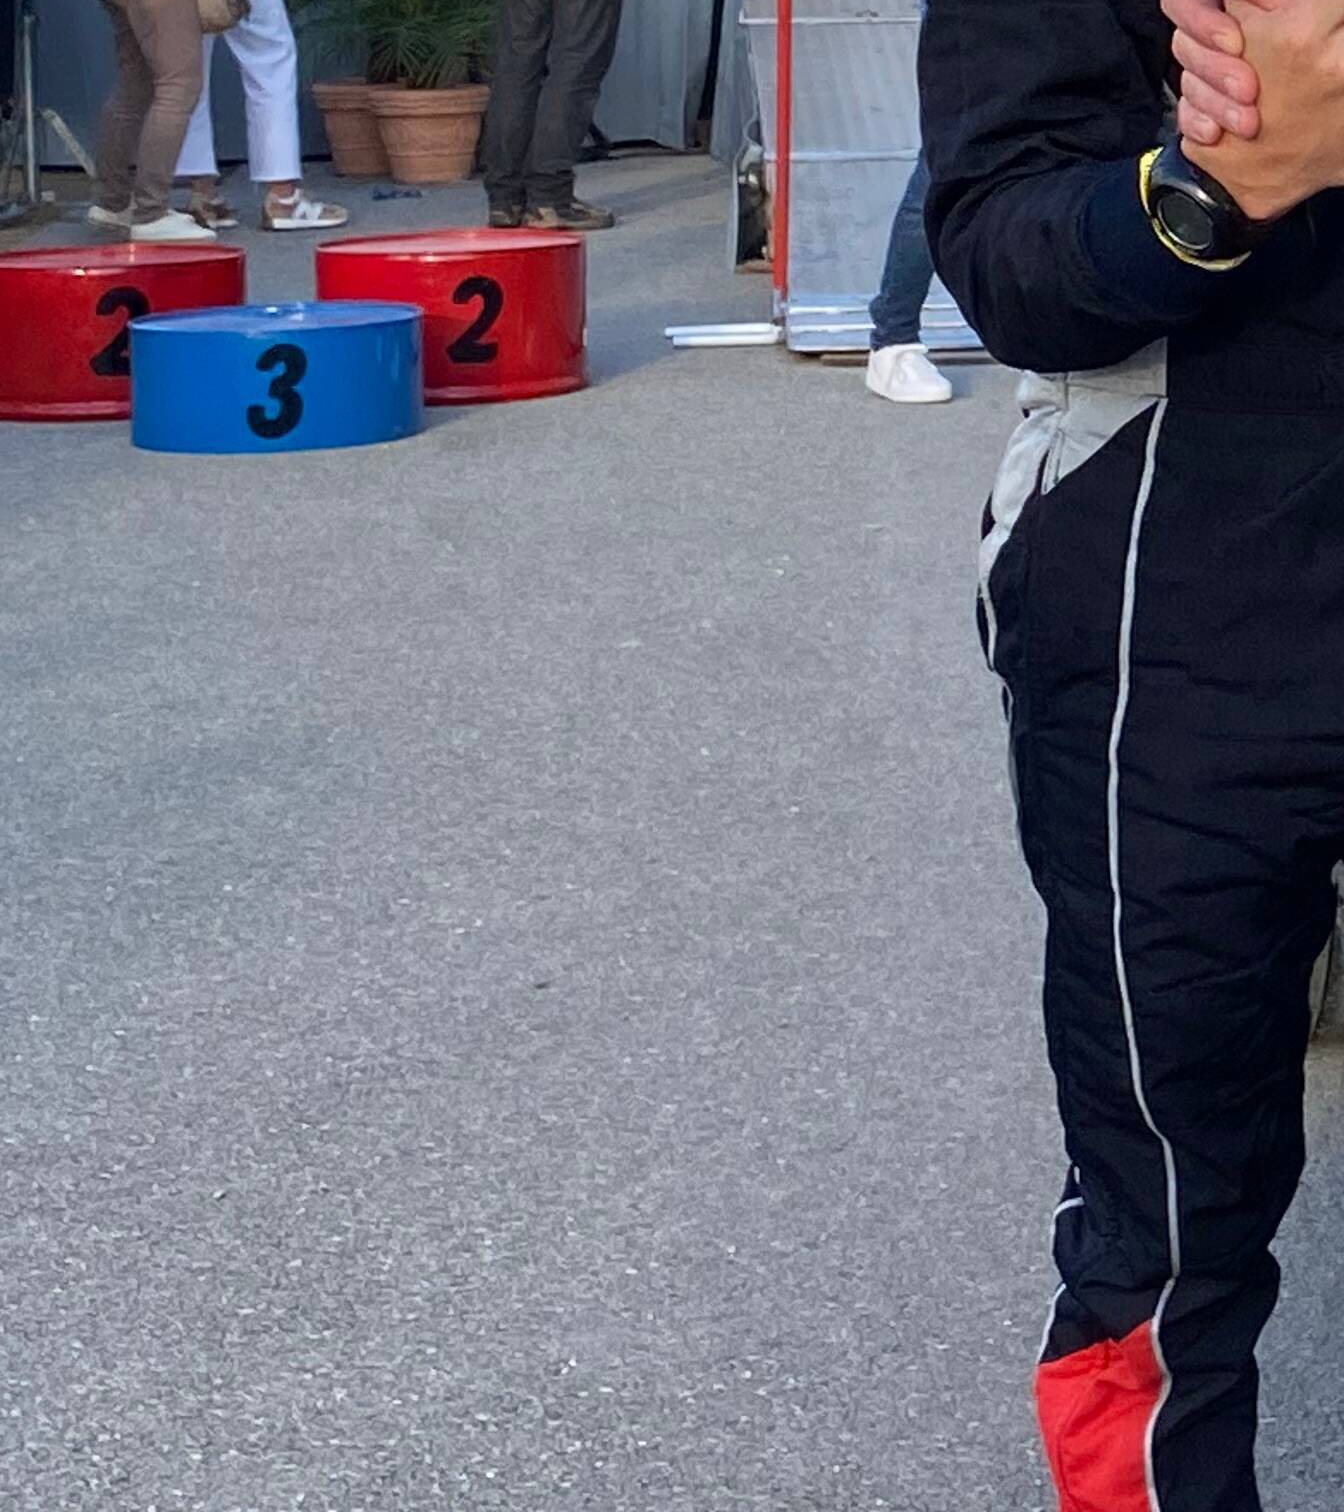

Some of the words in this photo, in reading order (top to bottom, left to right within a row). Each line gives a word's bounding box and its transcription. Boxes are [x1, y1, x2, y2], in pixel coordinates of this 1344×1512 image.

[90, 286, 151, 375] 2
[446, 275, 504, 364] 2
[246, 343, 307, 439] 3
